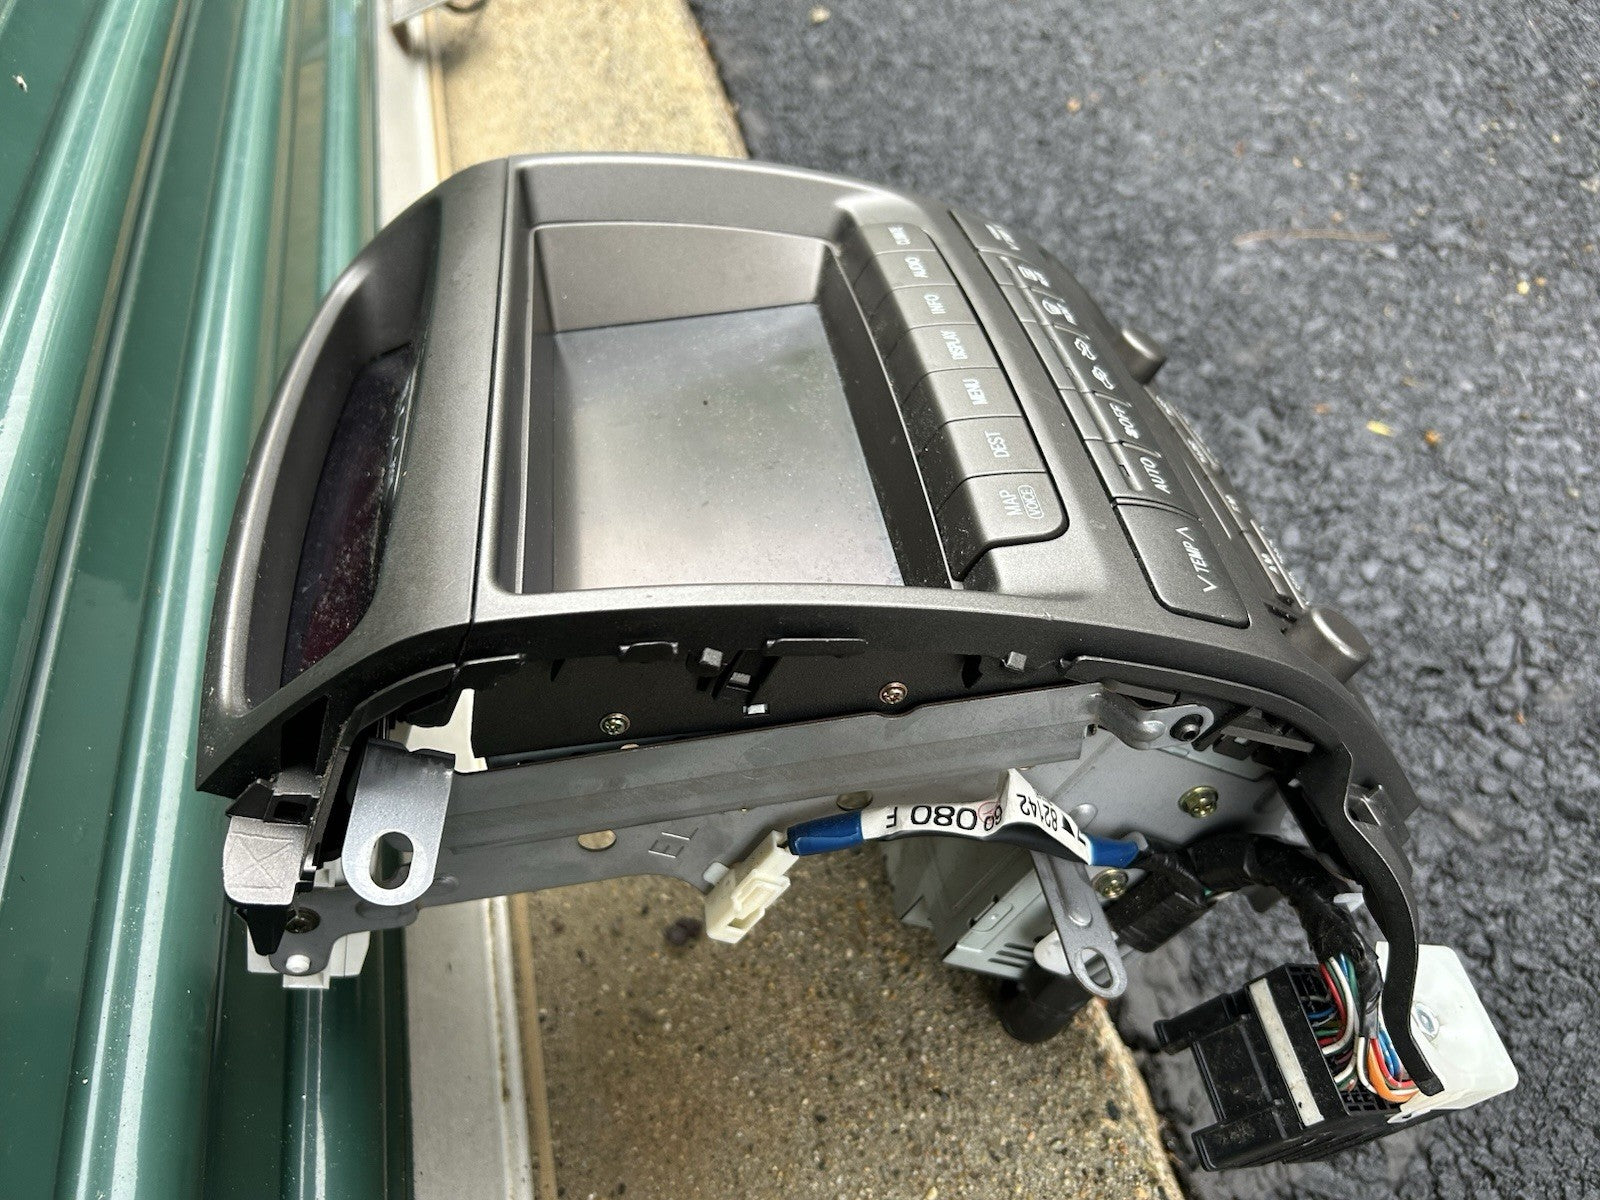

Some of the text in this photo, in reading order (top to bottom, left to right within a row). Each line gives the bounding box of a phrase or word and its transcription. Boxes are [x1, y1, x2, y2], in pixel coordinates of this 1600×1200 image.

[904, 255, 928, 279] AUDIO
[923, 293, 947, 315] INFO
[940, 329, 969, 361] DISPLAY
[962, 376, 989, 406] MENU
[983, 429, 1010, 459] DEST
[1139, 456, 1171, 494] AUTO
[998, 488, 1023, 517] MAP
[1182, 540, 1210, 573] TEMP
[885, 806, 899, 829] F
[1016, 793, 1058, 832] 82142
